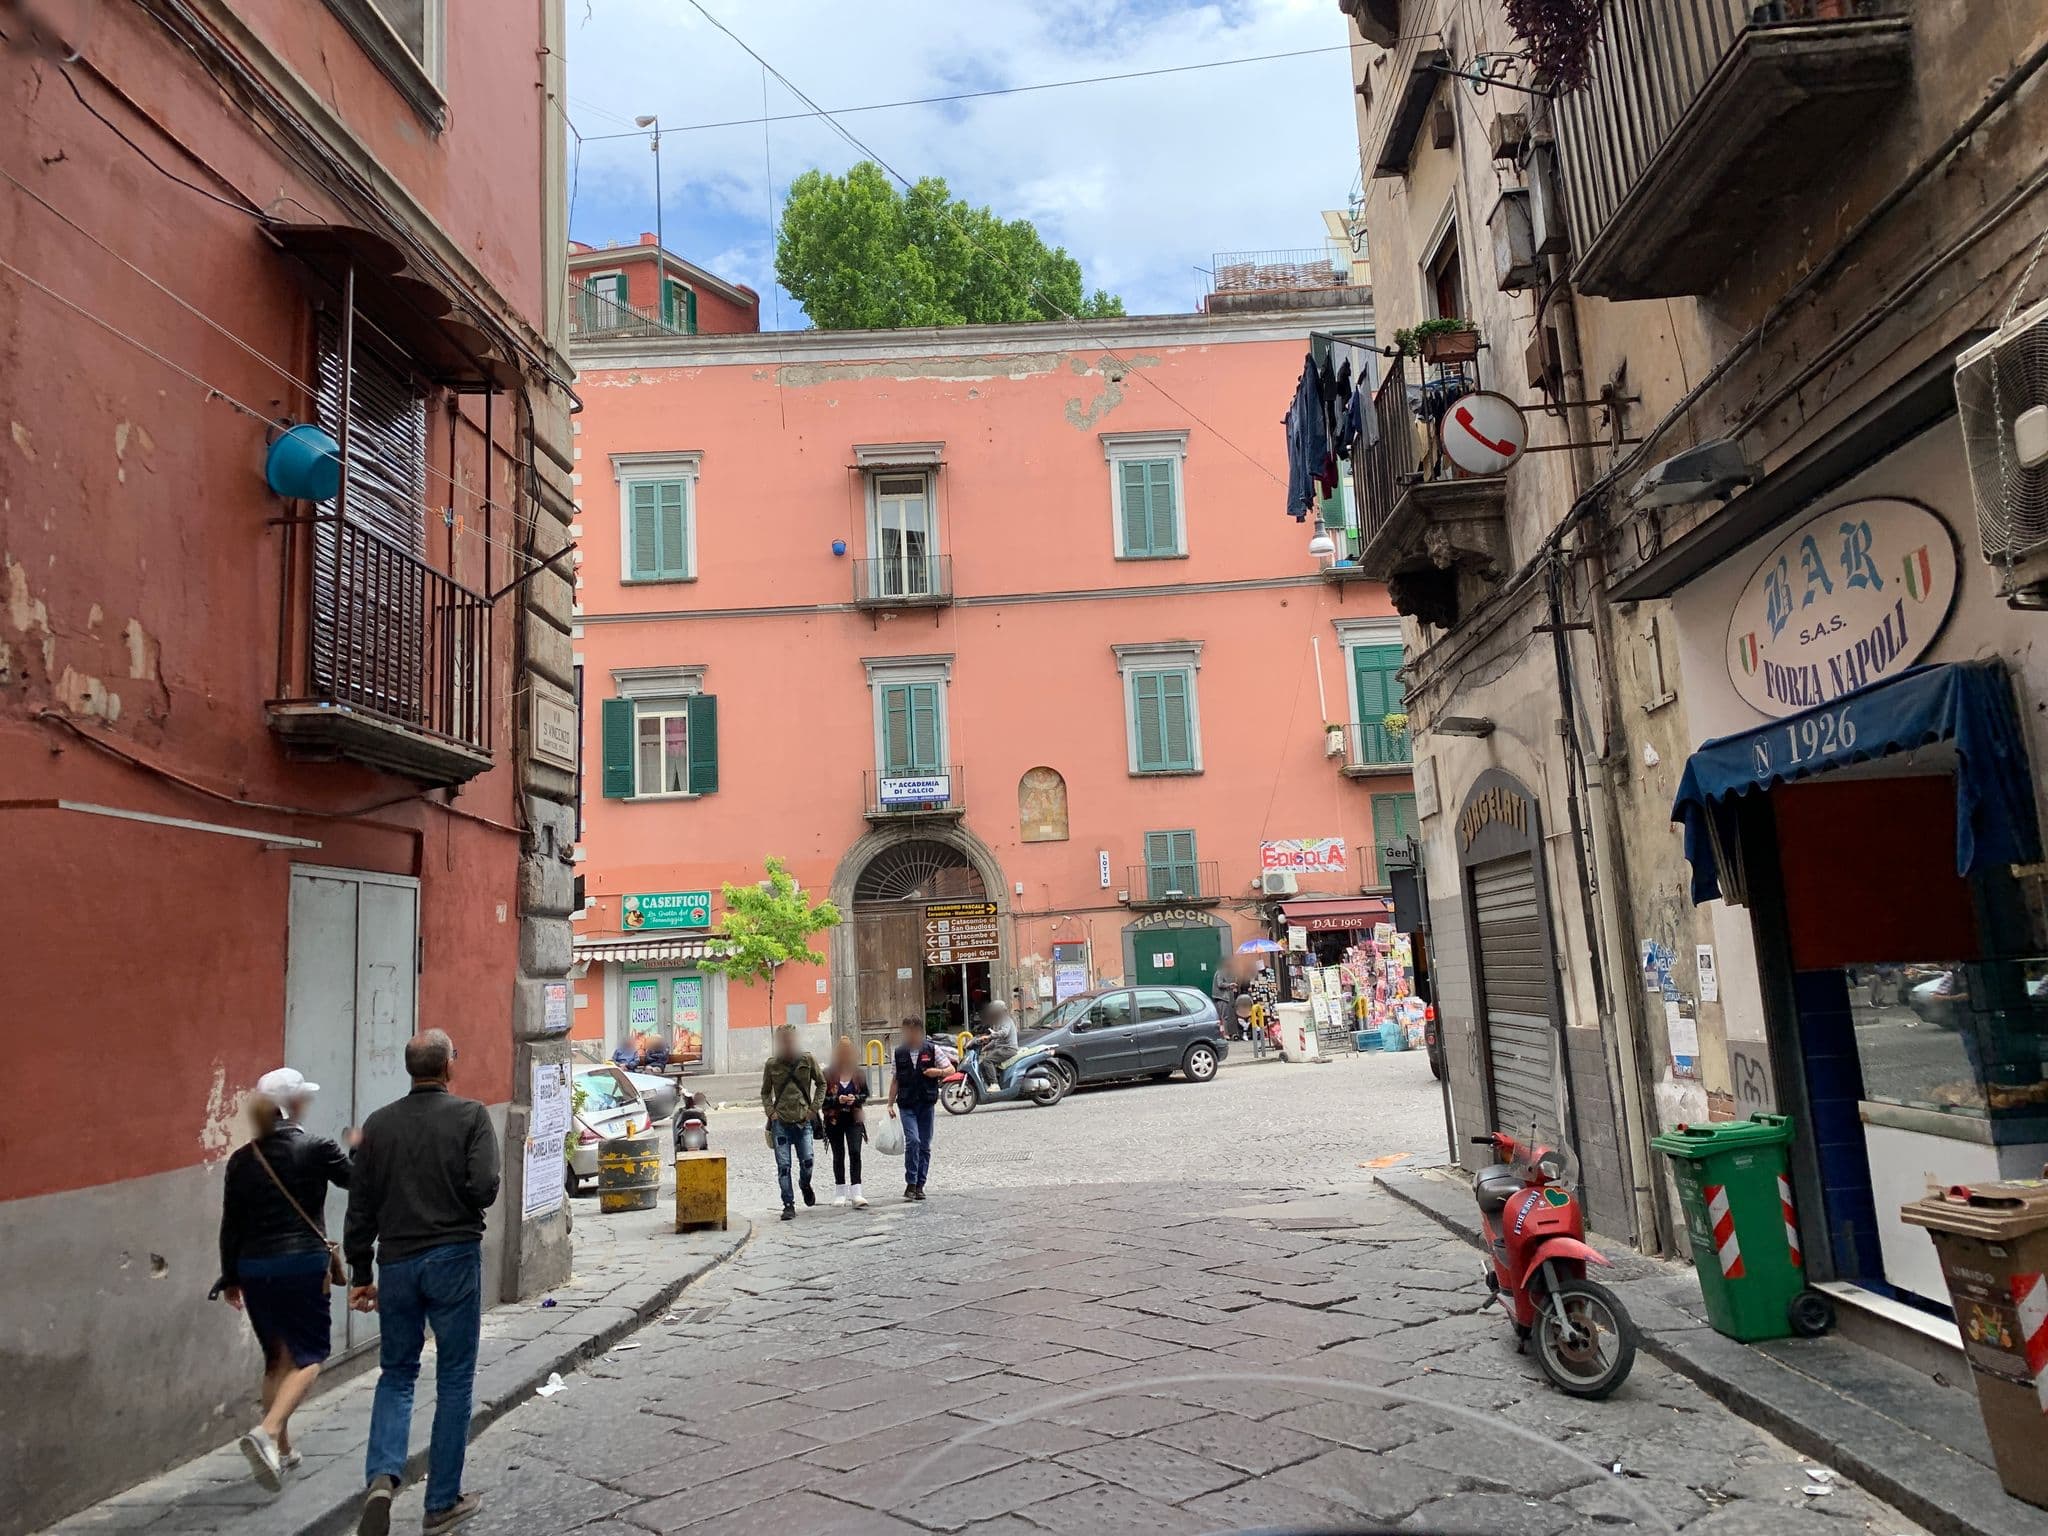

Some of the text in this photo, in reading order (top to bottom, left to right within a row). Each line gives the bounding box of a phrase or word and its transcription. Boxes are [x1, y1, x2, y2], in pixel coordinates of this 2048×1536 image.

[1764, 520, 1884, 643] BAR
[1800, 615, 1847, 645] S.A.S.
[1763, 598, 1909, 706] FORZA NAPOLI
[1755, 705, 1857, 773] N 1926
[1462, 786, 1528, 854] SURGELATI
[1262, 844, 1345, 867] EDICOLA
[642, 895, 707, 909] CASEIFICIO
[1134, 909, 1215, 930] TABACCHI
[1312, 918, 1362, 929] DAL 1905
[951, 932, 988, 940] Catacombe
[979, 949, 997, 957] Greci
[1952, 1266, 1995, 1284] UMIDO
